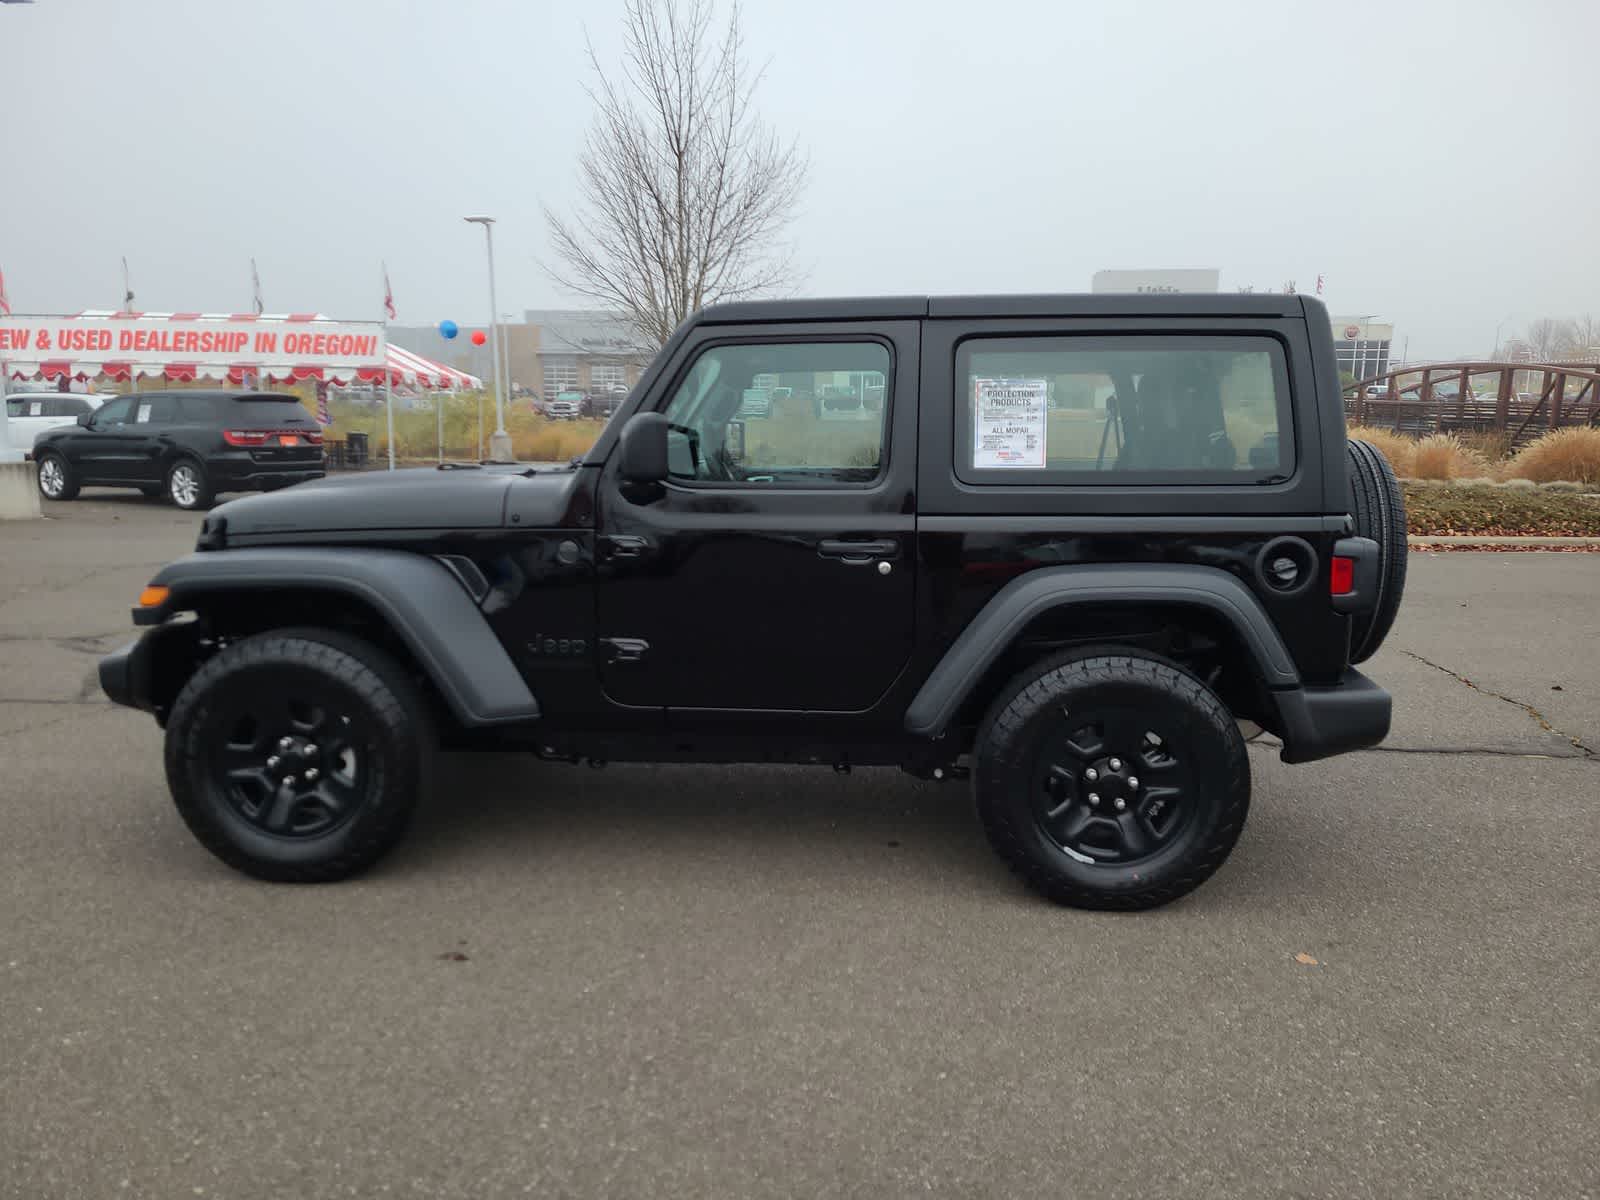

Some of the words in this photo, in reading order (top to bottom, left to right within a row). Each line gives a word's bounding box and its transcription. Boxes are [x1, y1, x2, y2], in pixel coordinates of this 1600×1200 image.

[35, 329, 52, 350] &
[57, 328, 113, 350] USED
[119, 329, 249, 353] DEALERSHIP
[254, 332, 277, 353] IN
[283, 333, 378, 356] OREGON!
[987, 390, 1035, 398] PROTECTION
